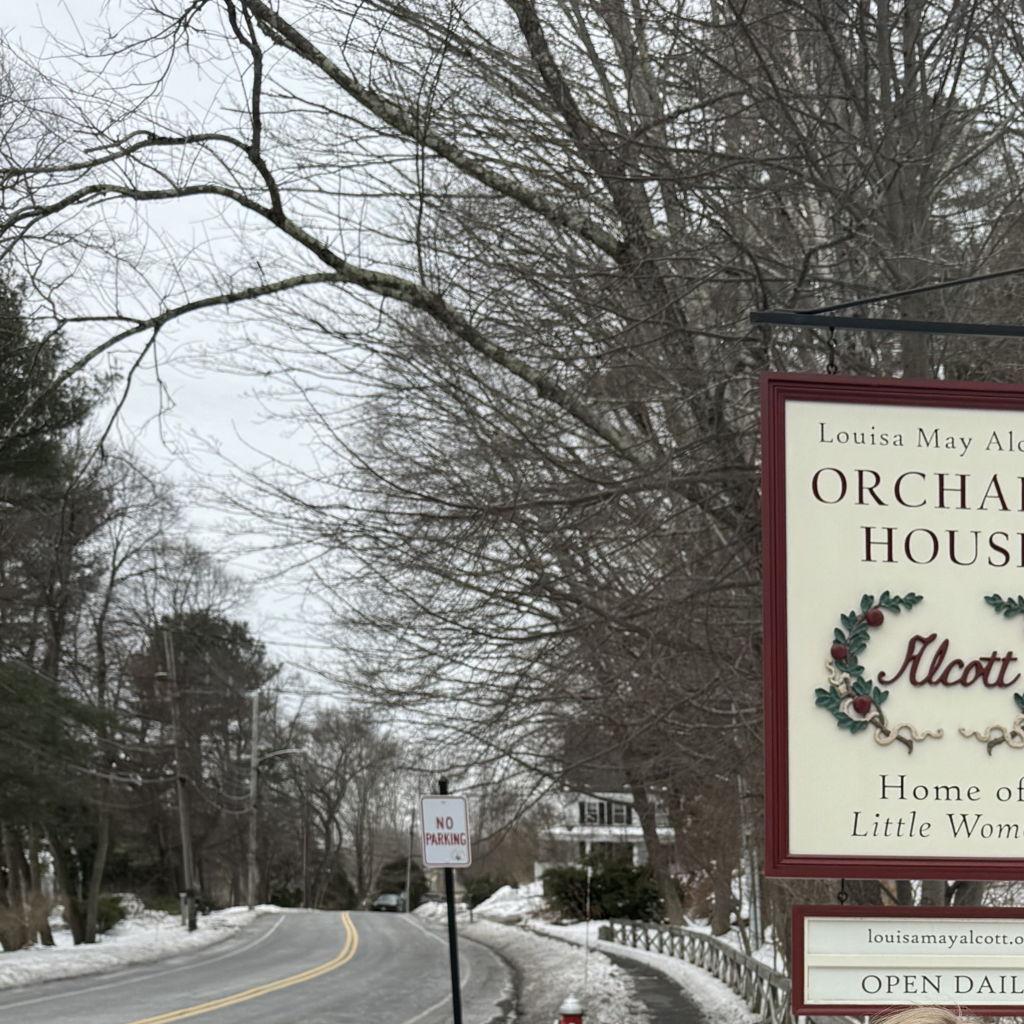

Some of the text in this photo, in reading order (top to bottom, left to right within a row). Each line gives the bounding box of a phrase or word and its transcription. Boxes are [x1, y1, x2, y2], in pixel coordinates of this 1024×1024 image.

[818, 421, 905, 447] Louisa
[916, 427, 974, 457] May
[877, 632, 1021, 689] Alcott
[878, 773, 981, 802] Home
[436, 816, 454, 830] NO
[850, 810, 932, 839] Little
[426, 832, 466, 846] PARKING
[860, 974, 943, 995] OPEN
